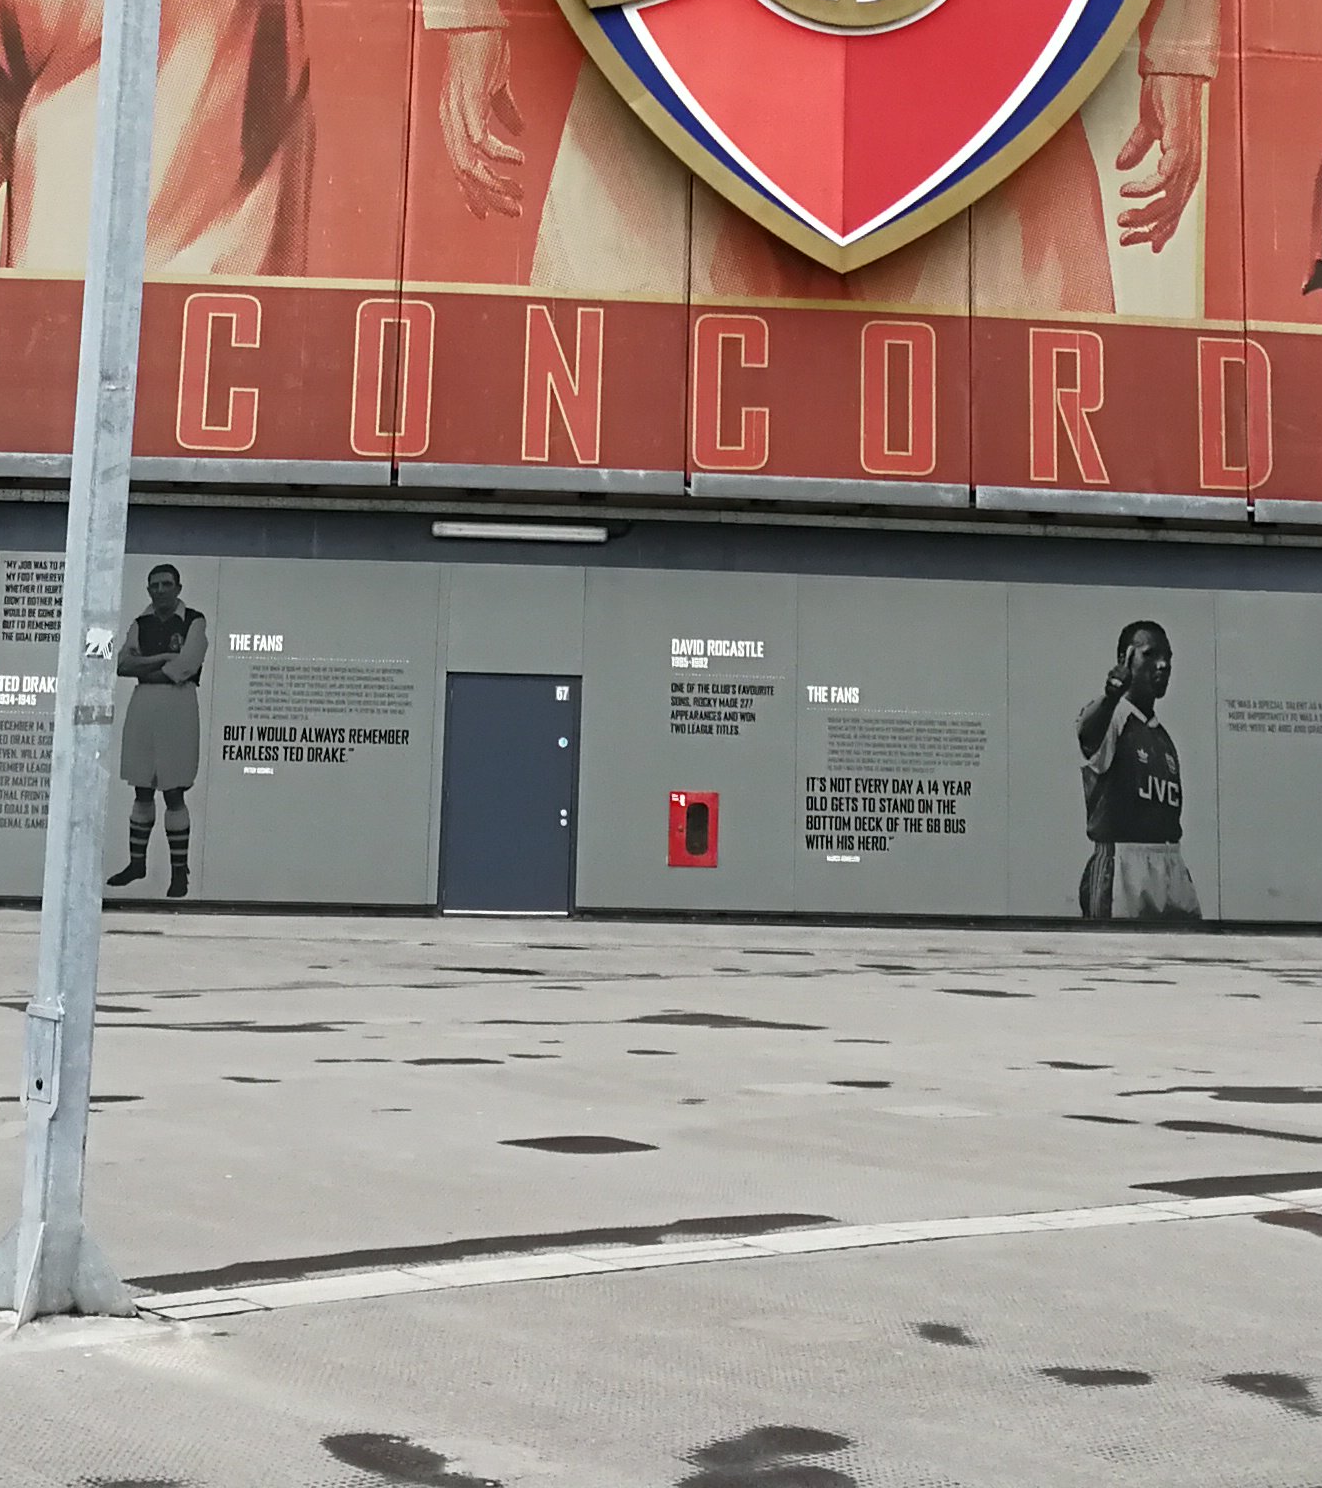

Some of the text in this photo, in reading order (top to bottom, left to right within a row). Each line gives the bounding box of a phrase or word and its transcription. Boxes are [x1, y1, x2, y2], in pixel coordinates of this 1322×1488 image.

[229, 634, 283, 651] THE FANS
[672, 638, 764, 657] DAVID ROCASTLE
[556, 686, 569, 701] 67
[671, 683, 774, 696] ONE OF THE CLUB'S FAVOURITE
[807, 686, 859, 703] THE FANS
[692, 697, 753, 709] ROCKY MADE 277
[671, 710, 756, 722] APPEARANCES AND WON
[224, 726, 409, 745] BUT I WOULD ALWAYS REMEMBER
[671, 724, 685, 733] TWO
[687, 724, 713, 734] LEAGUE
[223, 745, 280, 761] FEARLESS
[282, 746, 304, 762] TED
[26, 763, 51, 773] LEAGU
[806, 777, 971, 796] IT'S NOT EVERY DAY A 14 YEAR
[1139, 775, 1179, 808] JVC
[806, 796, 956, 814] OLD GETS TO STAND ON THE
[806, 815, 965, 833] BOTTOM DECK OF THE 68 BUS
[805, 835, 833, 850] WITH
[835, 836, 855, 850] HIS
